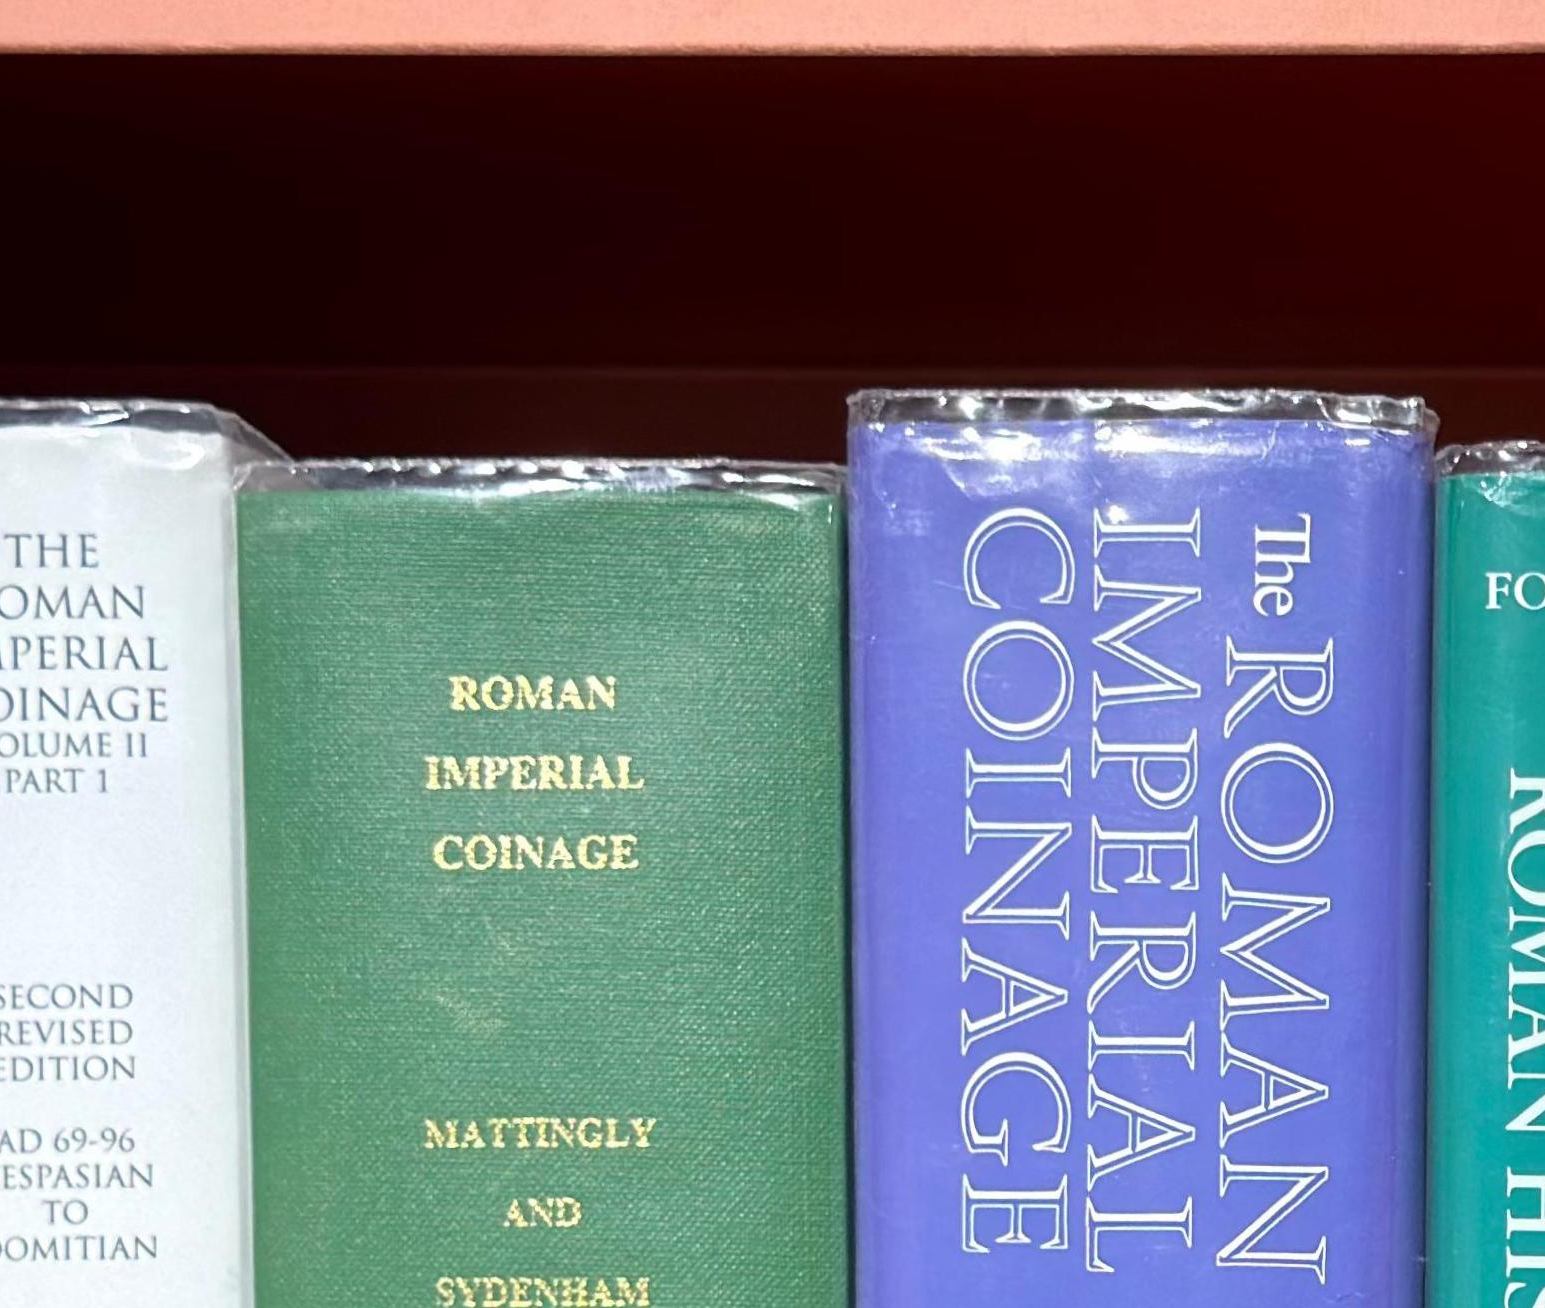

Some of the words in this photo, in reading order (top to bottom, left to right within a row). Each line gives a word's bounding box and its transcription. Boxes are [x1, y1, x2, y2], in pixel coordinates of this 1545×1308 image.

[3, 533, 100, 569] THE
[1251, 513, 1312, 618] The
[448, 675, 617, 713] ROMAN
[126, 732, 148, 758] II
[5, 768, 86, 794] PART
[98, 768, 109, 794] 1
[423, 755, 645, 792] IMPERIAL
[431, 833, 640, 872] COINAGE
[959, 506, 1078, 1256] COINAGE
[1084, 506, 1203, 1275] IMPERIAL
[1215, 637, 1336, 1286] ROMAN
[54, 1127, 136, 1154] 69-96
[423, 1115, 658, 1151] MATTINGLY
[42, 1199, 89, 1226] TO
[503, 1196, 583, 1229] AND
